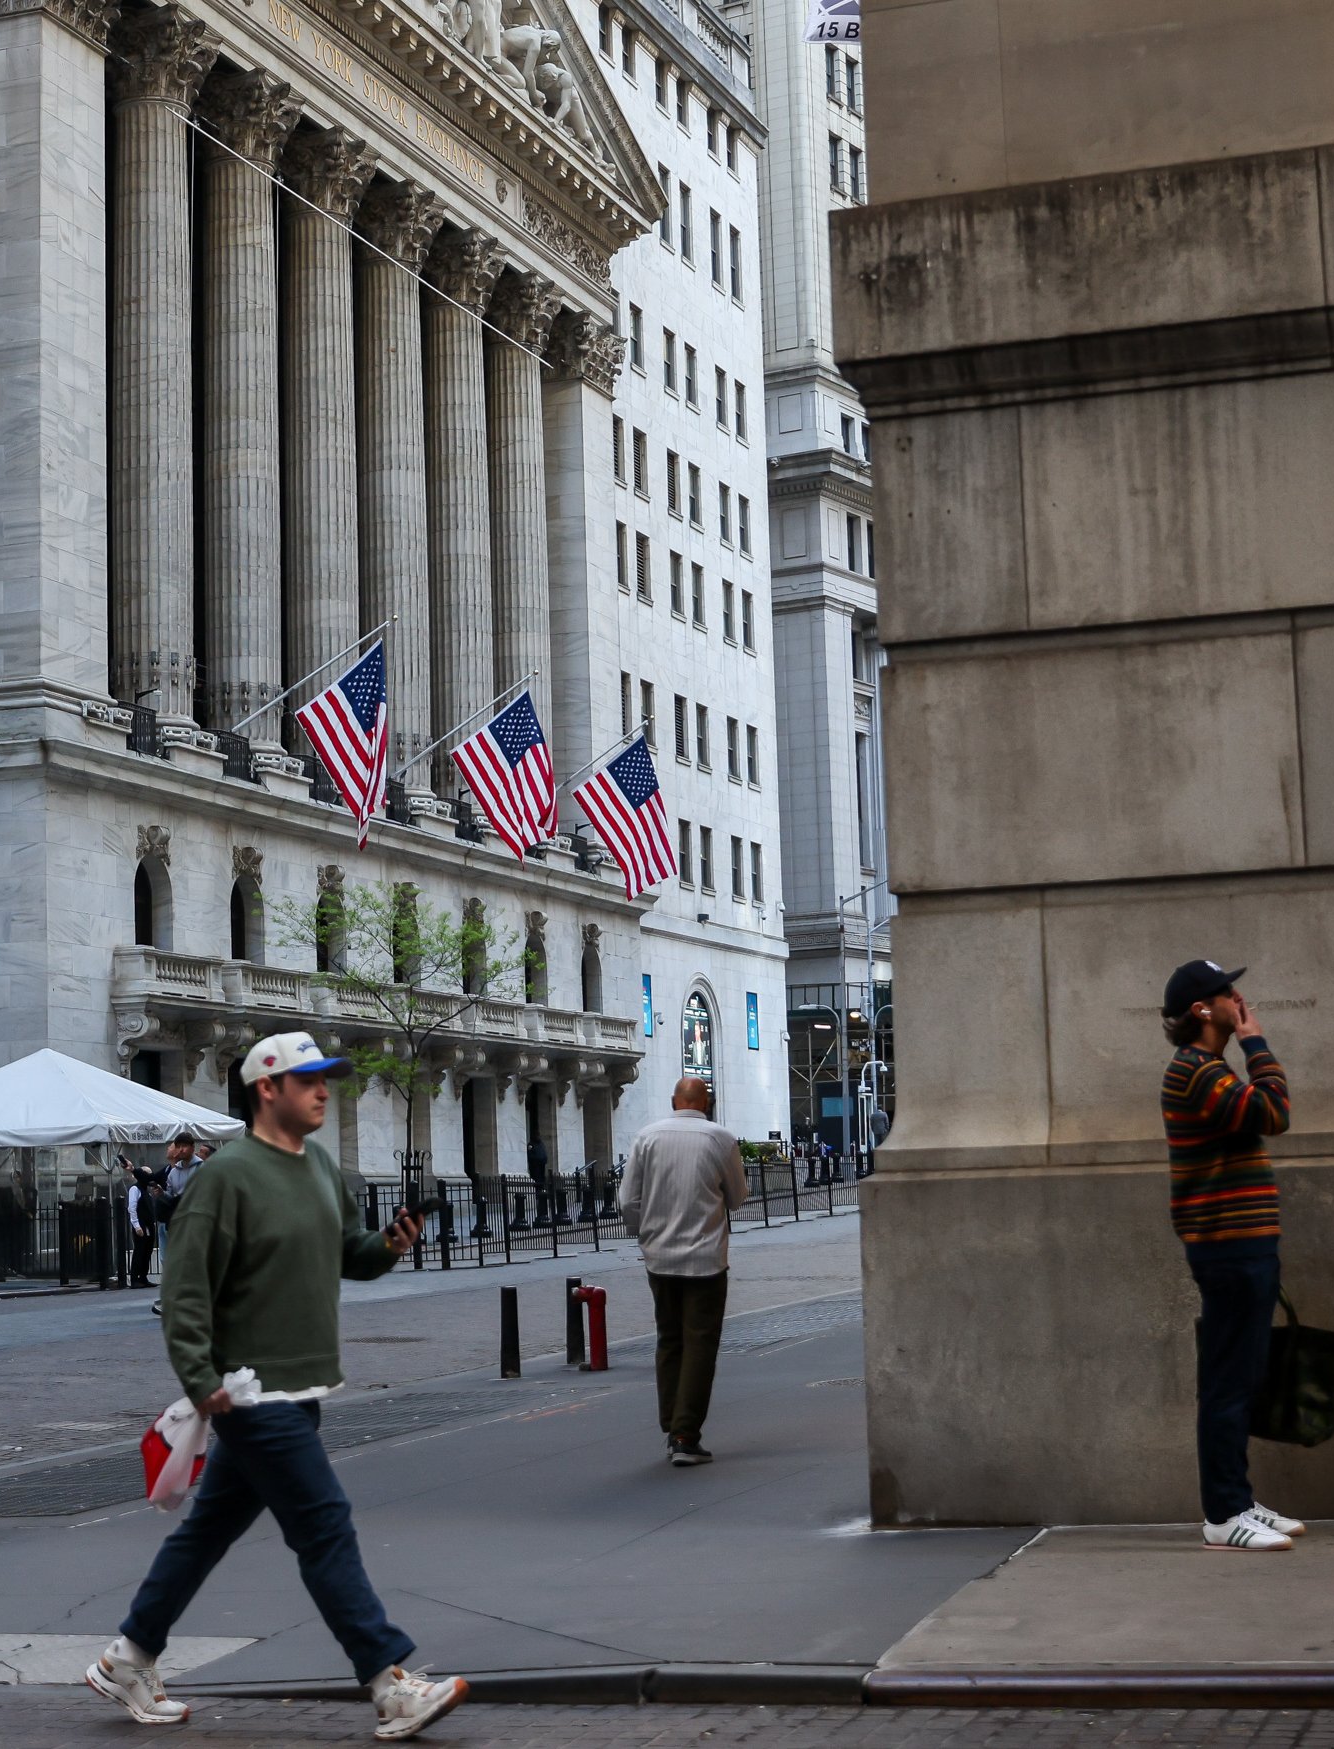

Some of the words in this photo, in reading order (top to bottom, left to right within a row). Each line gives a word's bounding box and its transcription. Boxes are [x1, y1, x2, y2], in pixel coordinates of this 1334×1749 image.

[817, 21, 839, 38] 15
[268, 0, 303, 44] NEW
[311, 31, 354, 88] YORK
[362, 72, 408, 130] STOCK
[415, 112, 486, 189] EXCHANGE
